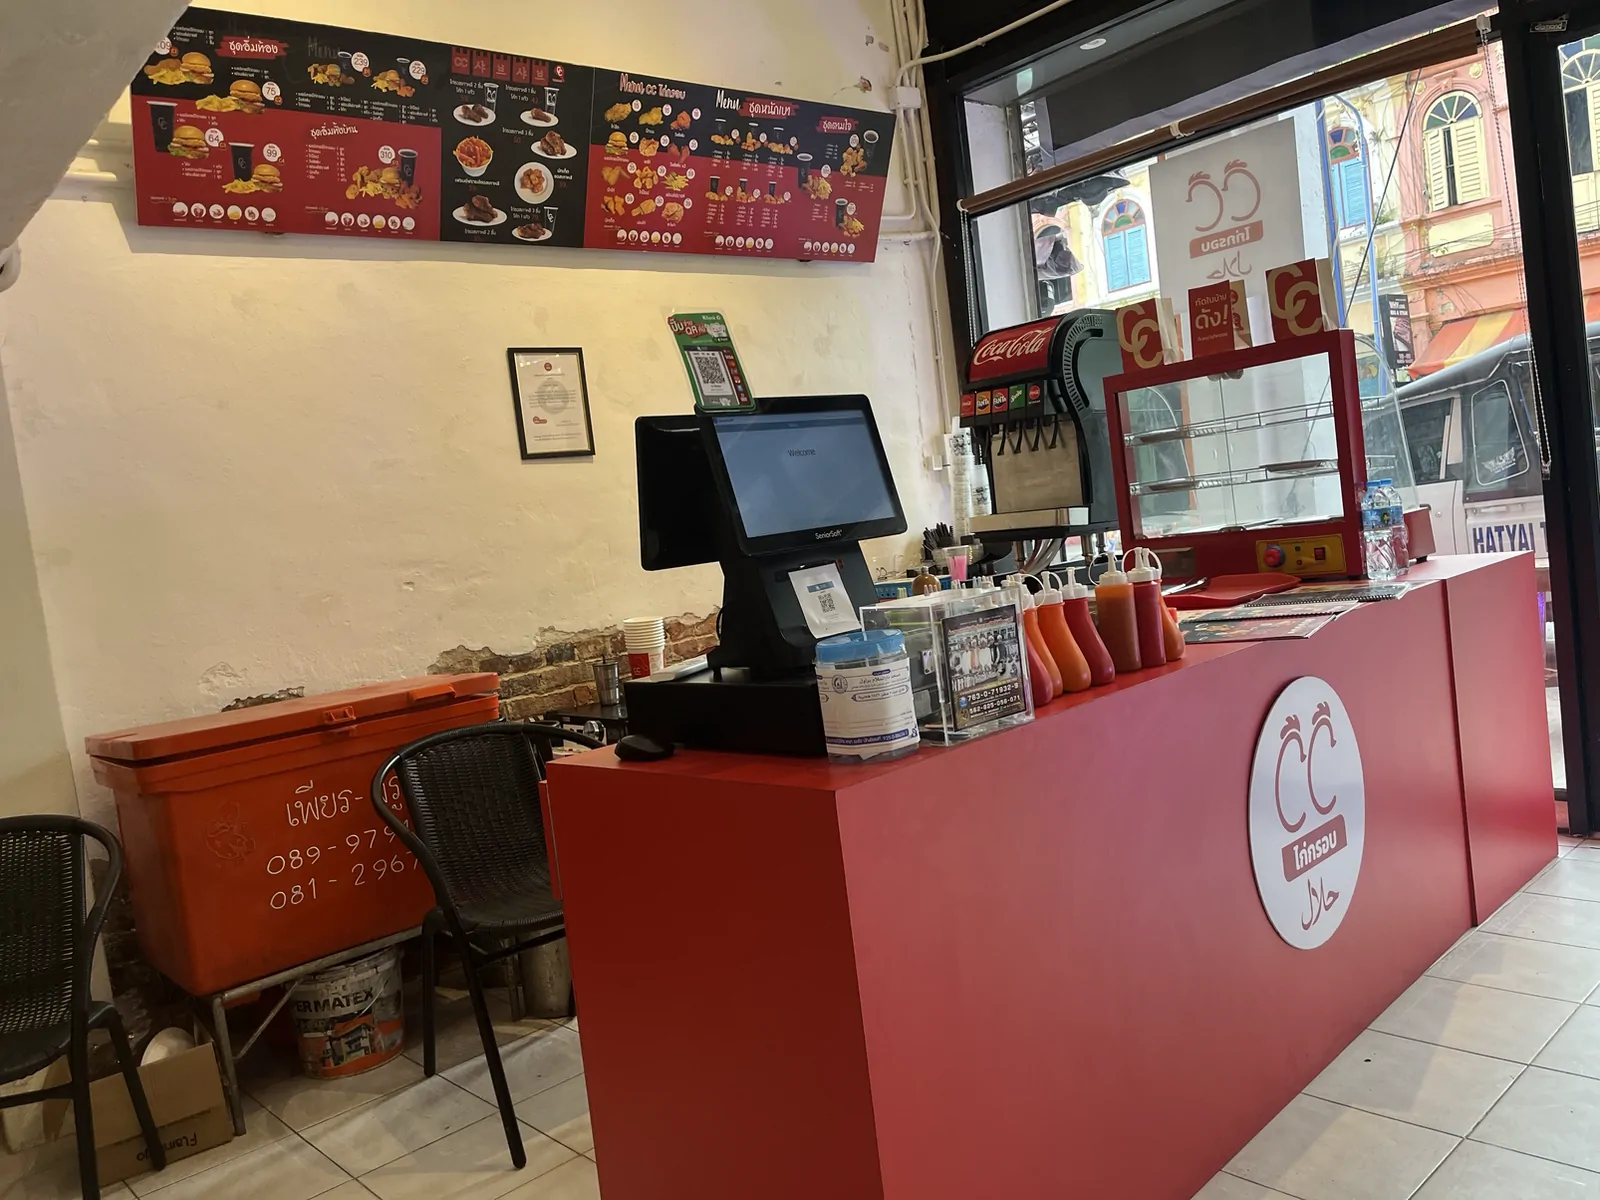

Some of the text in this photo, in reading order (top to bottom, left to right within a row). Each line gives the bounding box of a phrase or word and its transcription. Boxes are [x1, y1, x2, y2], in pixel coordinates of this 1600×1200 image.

[156, 40, 171, 50] 09
[228, 35, 279, 55] ชุดอิ่มท้อง
[266, 86, 277, 96] 75
[715, 89, 740, 111] Menu
[208, 134, 220, 143] 64
[266, 148, 278, 158] 99
[380, 150, 393, 159] 310
[1267, 263, 1323, 337] CC
[787, 448, 816, 457] Welcome
[814, 530, 842, 540] SeniorSoft
[1472, 522, 1535, 553] HATYAI
[1292, 829, 1337, 871] ไก่กรอบ
[1301, 876, 1339, 930] حلال
